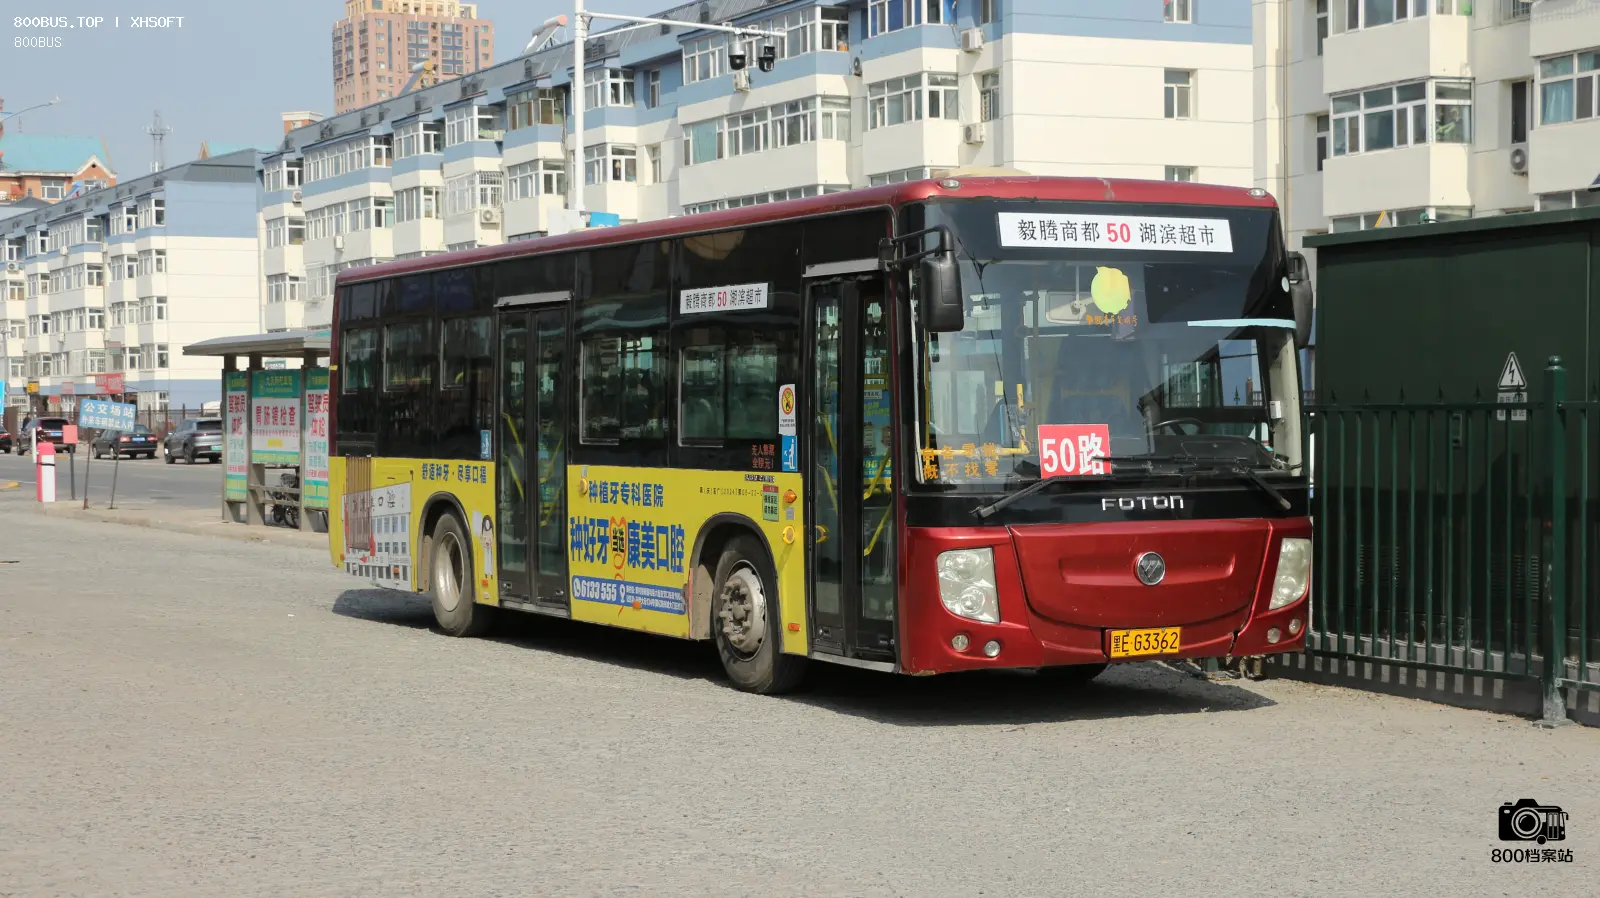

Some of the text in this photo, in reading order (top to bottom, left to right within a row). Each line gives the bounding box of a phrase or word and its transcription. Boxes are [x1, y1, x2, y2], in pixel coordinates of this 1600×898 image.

[1017, 218, 1215, 246] 毅腾商都 50 湖滨超市
[717, 291, 727, 307] 50
[84, 402, 134, 418] 公交场站
[255, 405, 296, 426] 胃肠镜检查
[1042, 432, 1106, 475] 50路
[588, 480, 664, 508] 种植牙专科医院
[1101, 495, 1184, 511] FOTON
[570, 515, 610, 565] 种好牙
[627, 519, 685, 573] 康美口腔
[581, 580, 600, 600] 6133
[601, 582, 618, 602] 555
